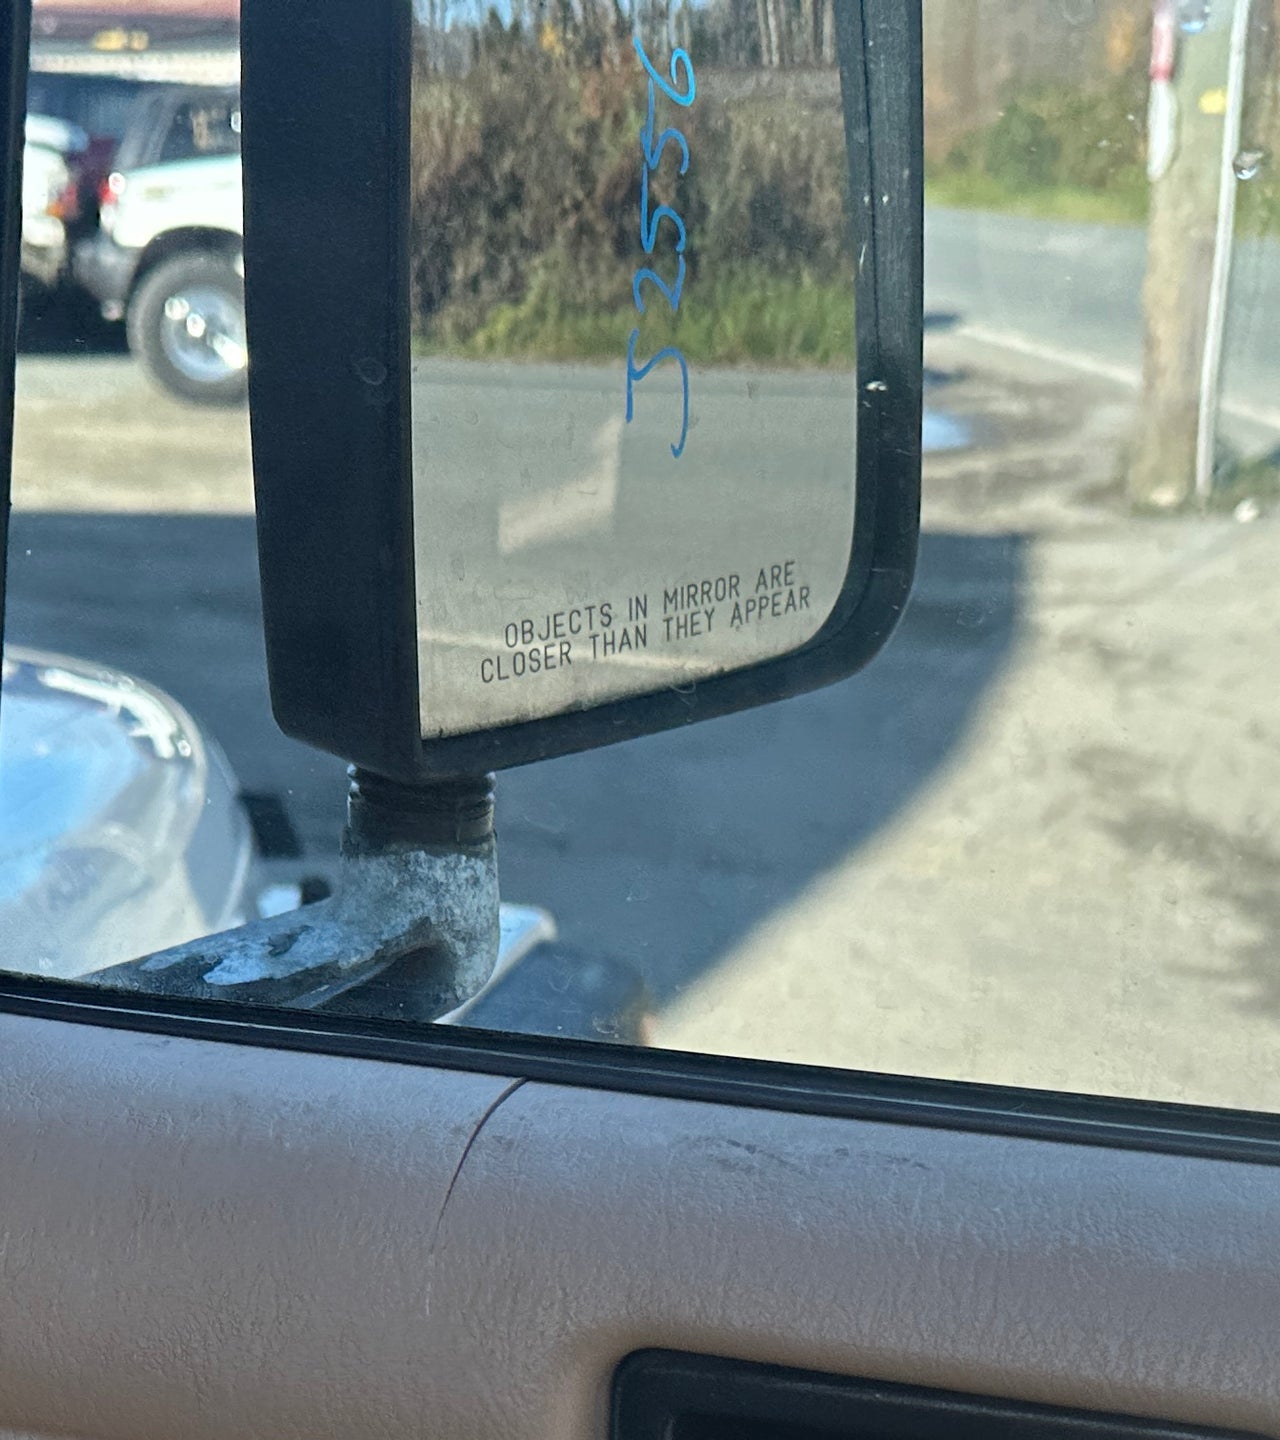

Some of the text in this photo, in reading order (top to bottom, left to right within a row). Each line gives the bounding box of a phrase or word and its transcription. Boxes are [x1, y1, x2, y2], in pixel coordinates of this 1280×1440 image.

[480, 586, 811, 684] CLOSER THAN THEY APPEAR
[505, 561, 796, 649] OBJECTS IN MIRROR ARE
